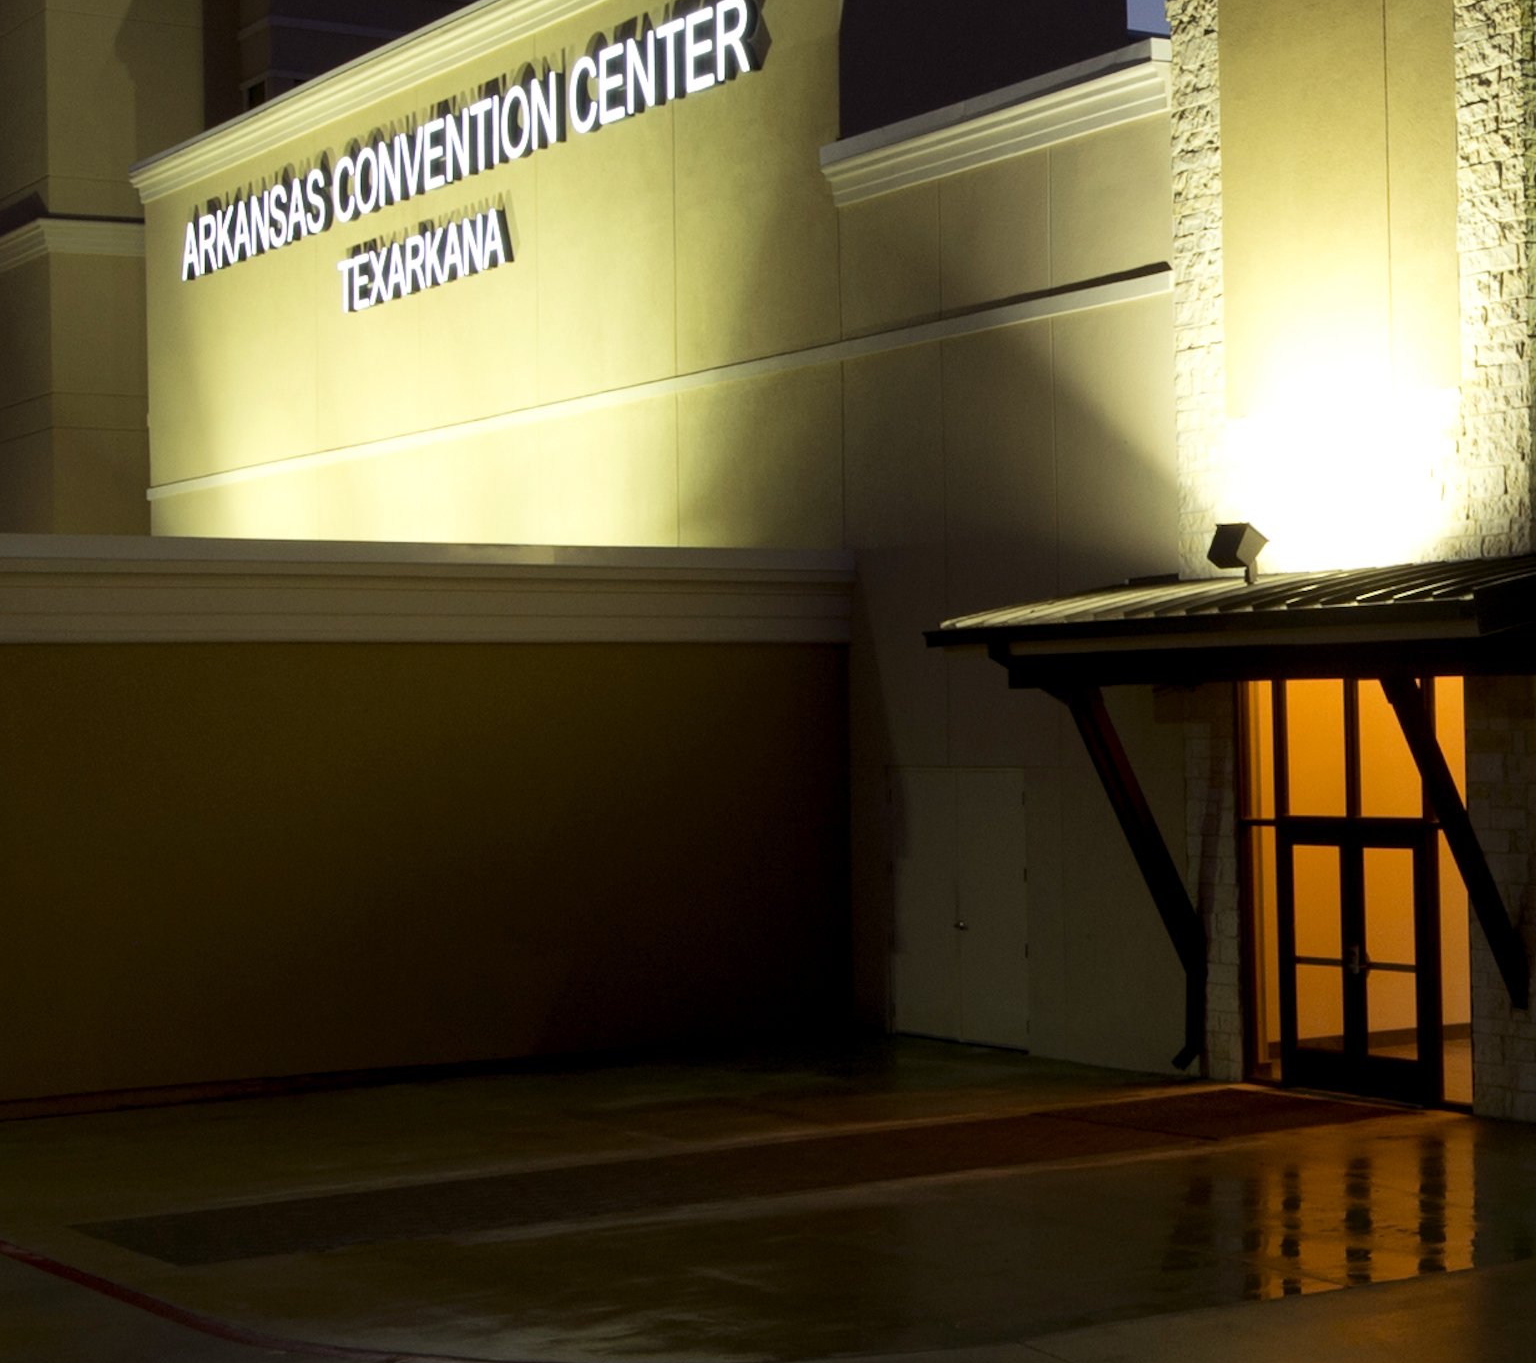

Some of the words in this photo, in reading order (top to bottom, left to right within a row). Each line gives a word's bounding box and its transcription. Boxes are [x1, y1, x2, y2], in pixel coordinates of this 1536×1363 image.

[181, 167, 325, 282] ARKANSAS
[332, 70, 557, 223] CONVENTION
[337, 208, 506, 314] TEXARKANA
